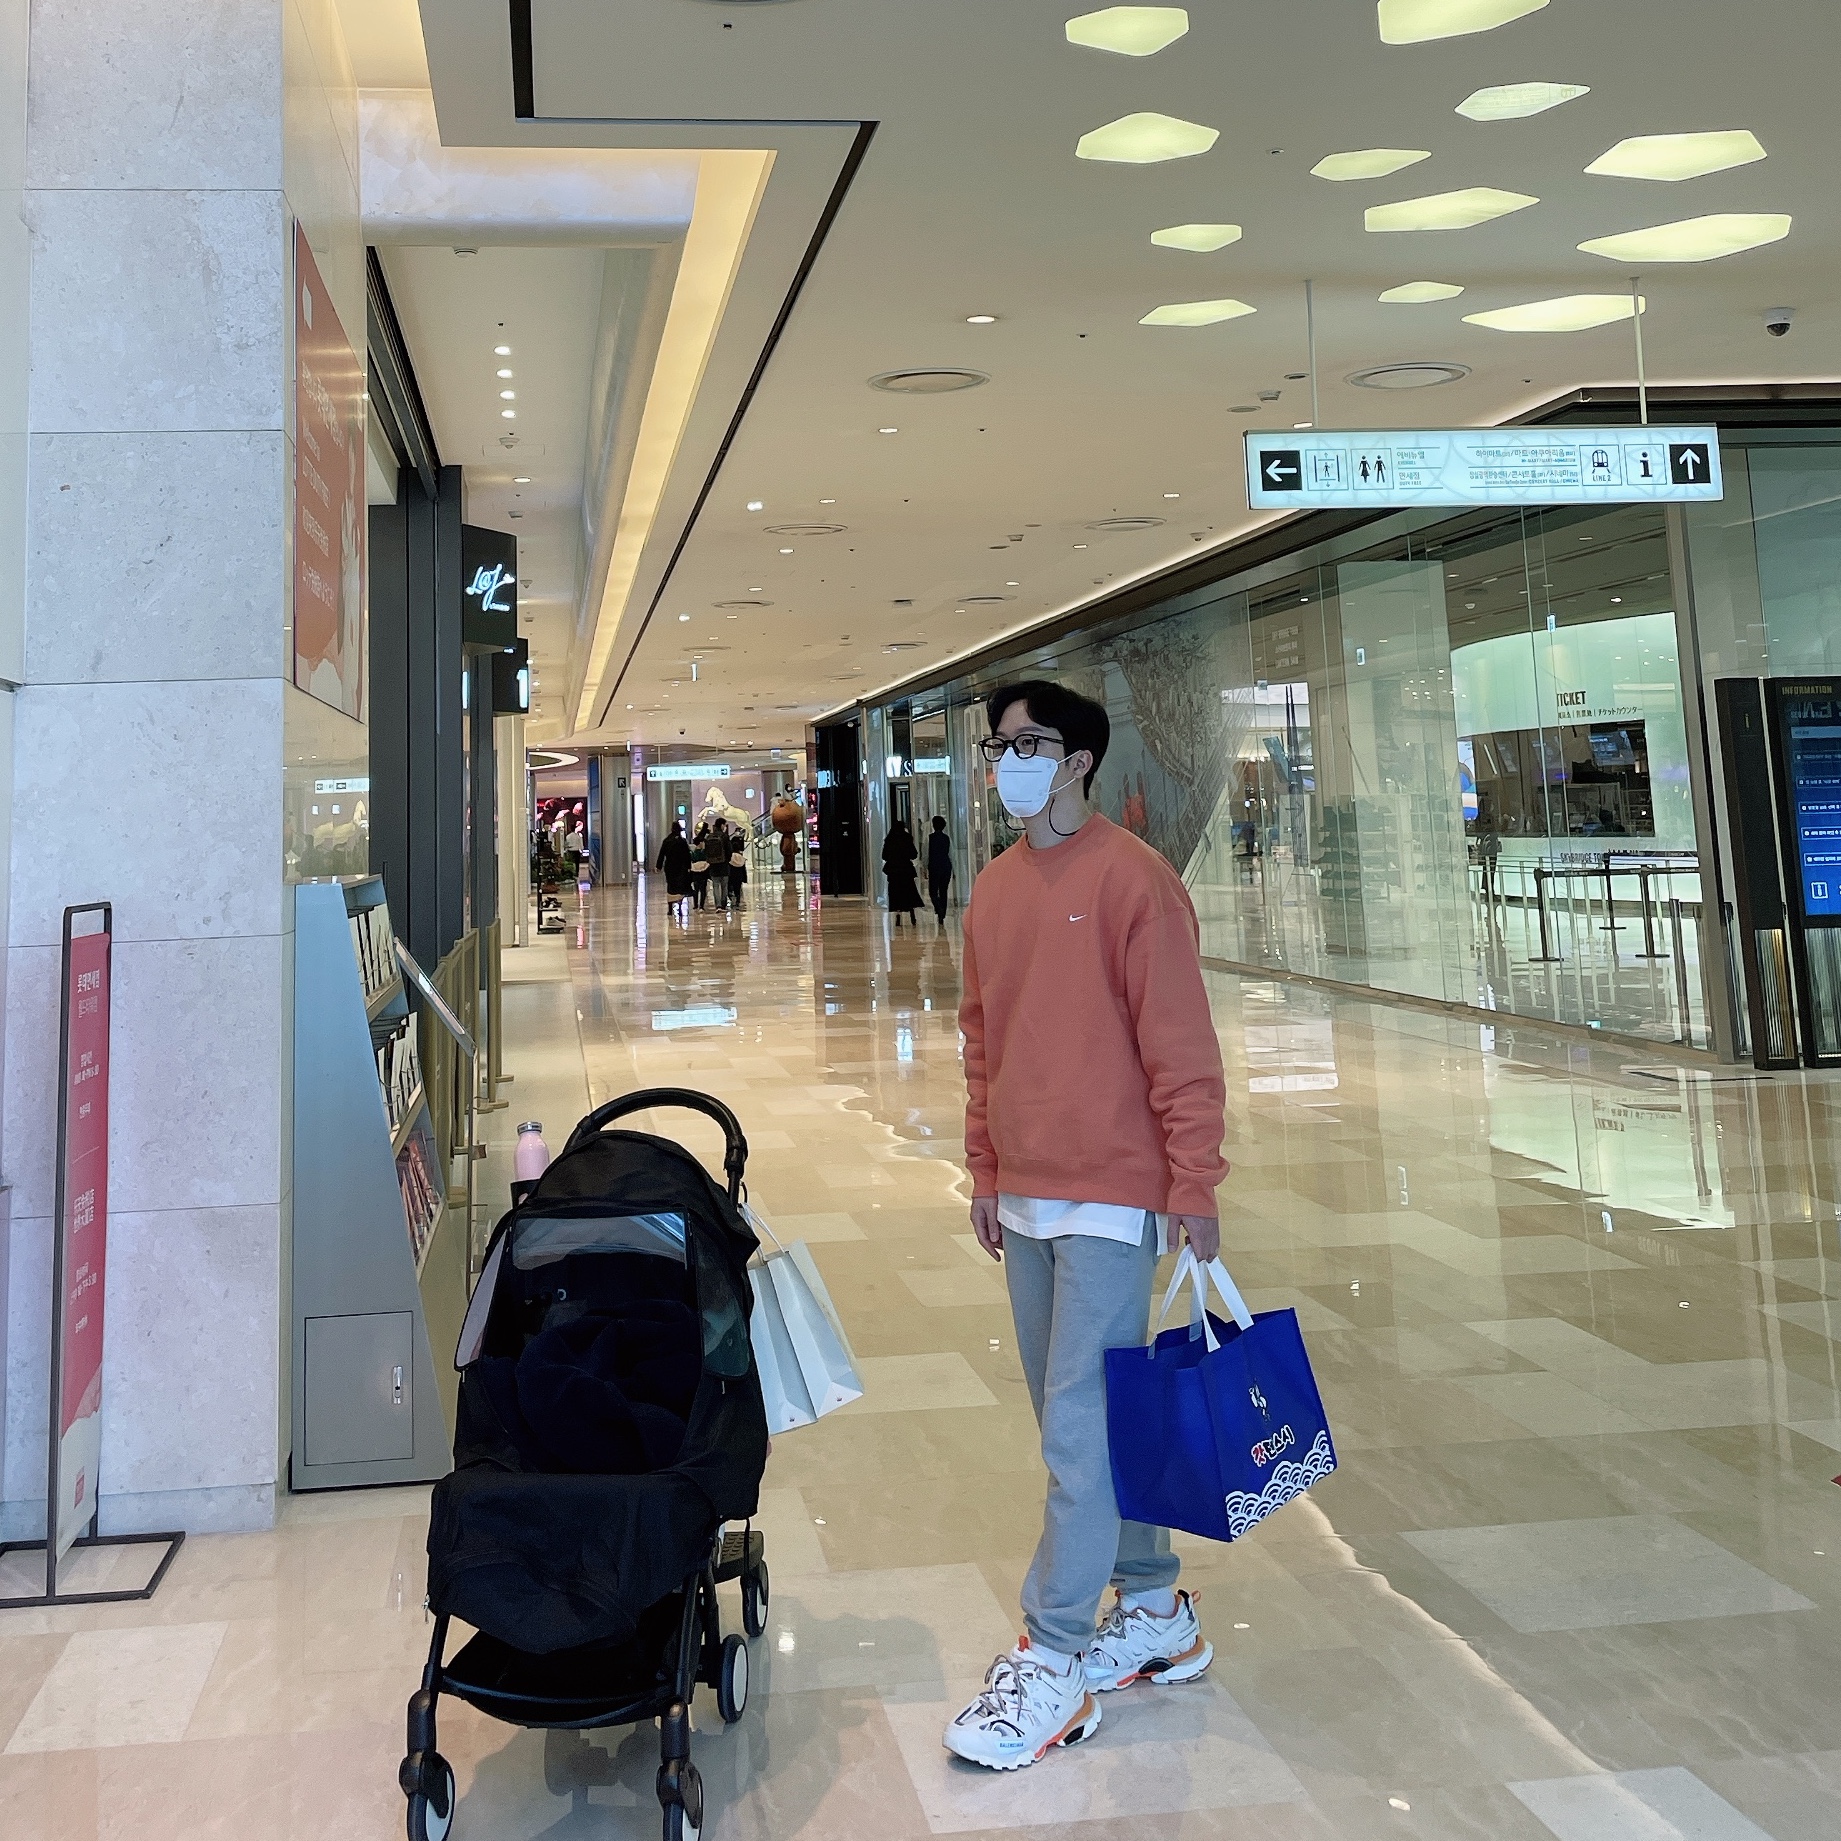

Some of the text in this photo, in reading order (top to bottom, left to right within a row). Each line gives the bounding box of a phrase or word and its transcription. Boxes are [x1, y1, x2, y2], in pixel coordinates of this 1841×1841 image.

[1396, 451, 1425, 460] 에비뉴엘
[1398, 471, 1421, 480] 면세점
[1592, 474, 1606, 482] LINE
[1781, 685, 1833, 695] INFORMATION
[1556, 691, 1587, 707] TICKET
